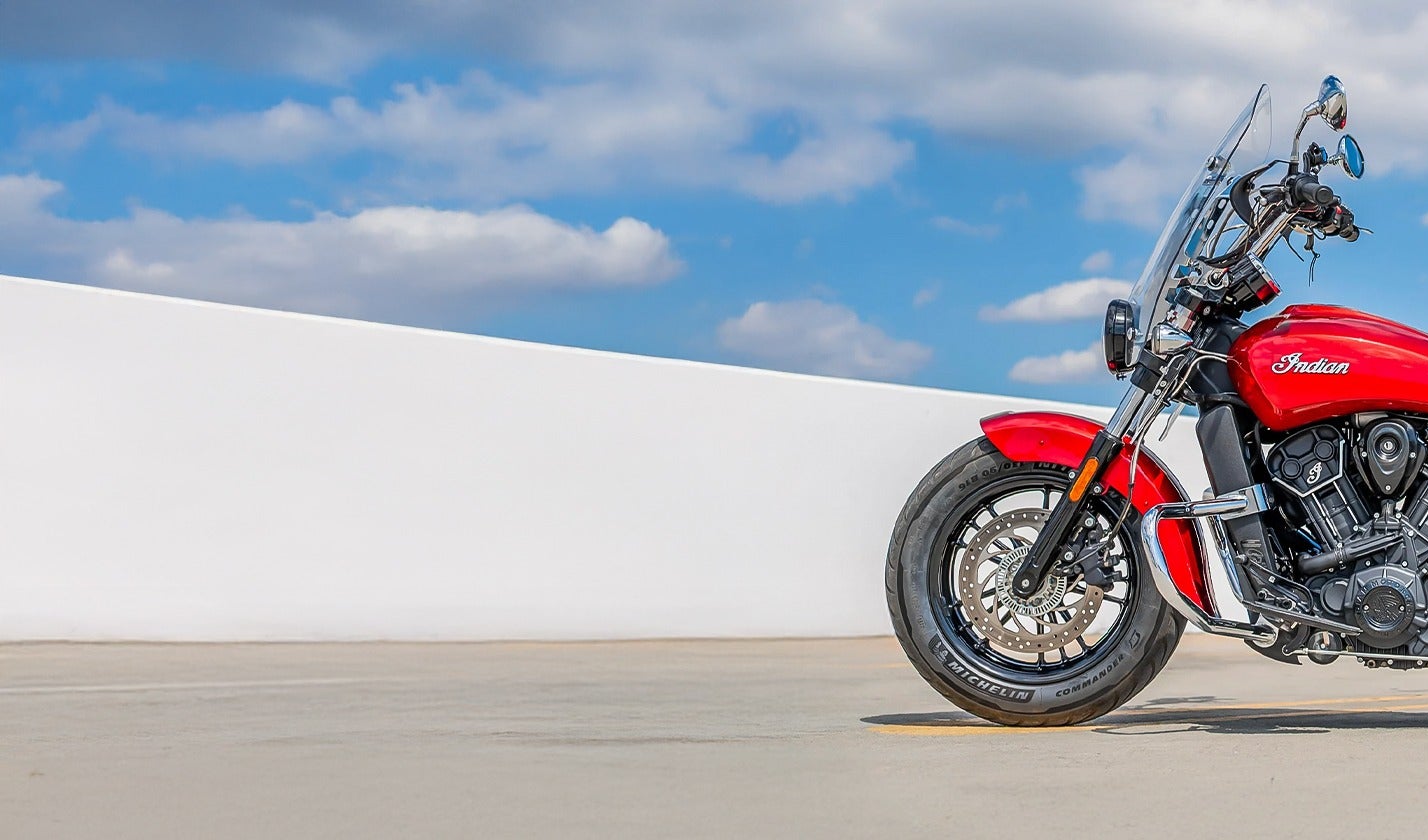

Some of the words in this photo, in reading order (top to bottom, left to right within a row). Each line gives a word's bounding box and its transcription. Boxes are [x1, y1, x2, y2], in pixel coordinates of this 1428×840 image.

[1271, 352, 1350, 374] Indian
[947, 661, 1029, 700] MICHELIN
[1055, 653, 1125, 697] COMMANDER
